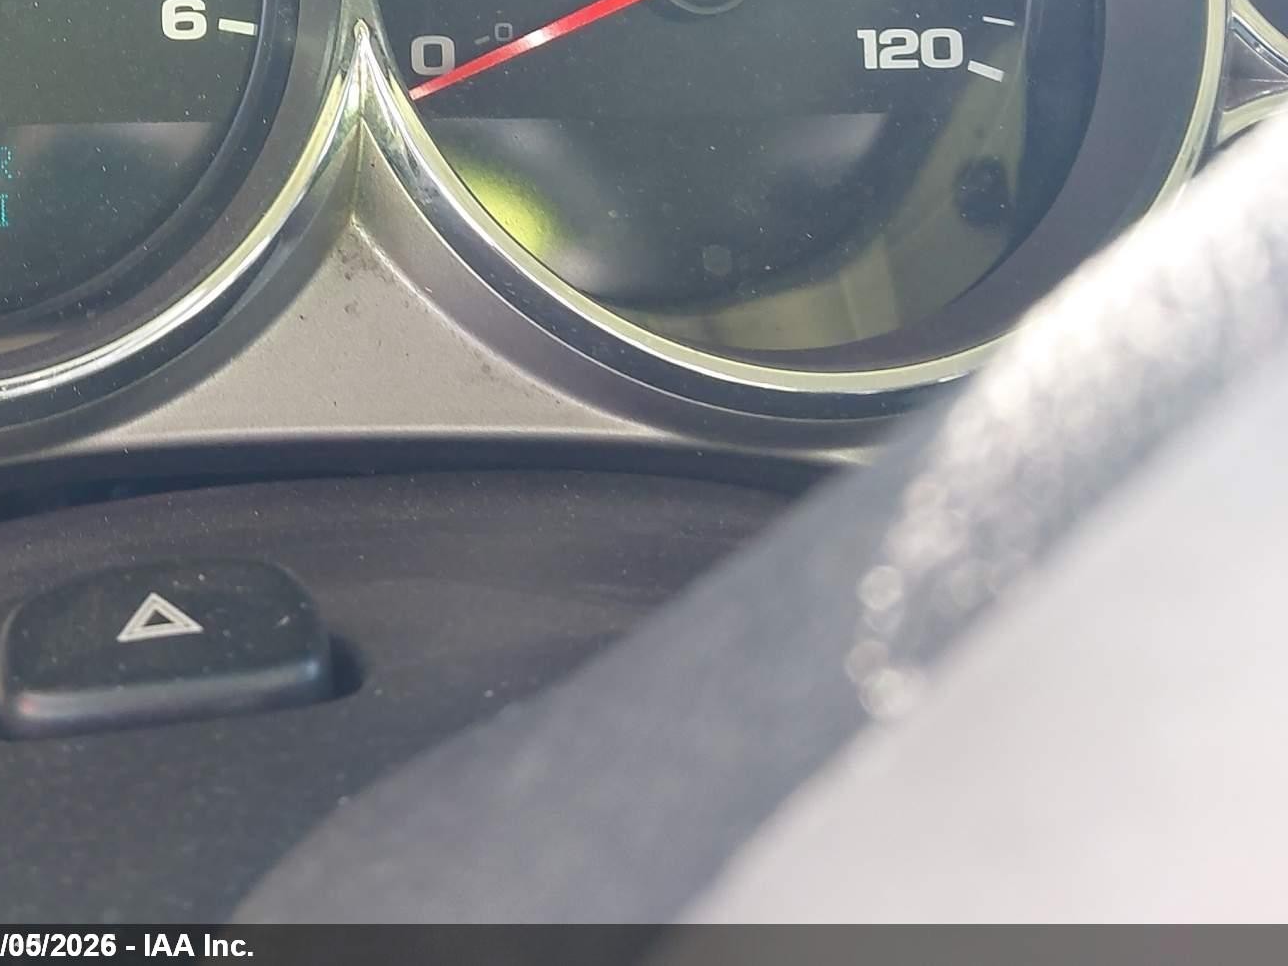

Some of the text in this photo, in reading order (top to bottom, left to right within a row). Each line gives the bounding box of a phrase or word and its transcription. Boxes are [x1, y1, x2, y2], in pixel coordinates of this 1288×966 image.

[494, 22, 513, 42] 0
[857, 28, 964, 70] 120
[411, 35, 455, 76] 0
